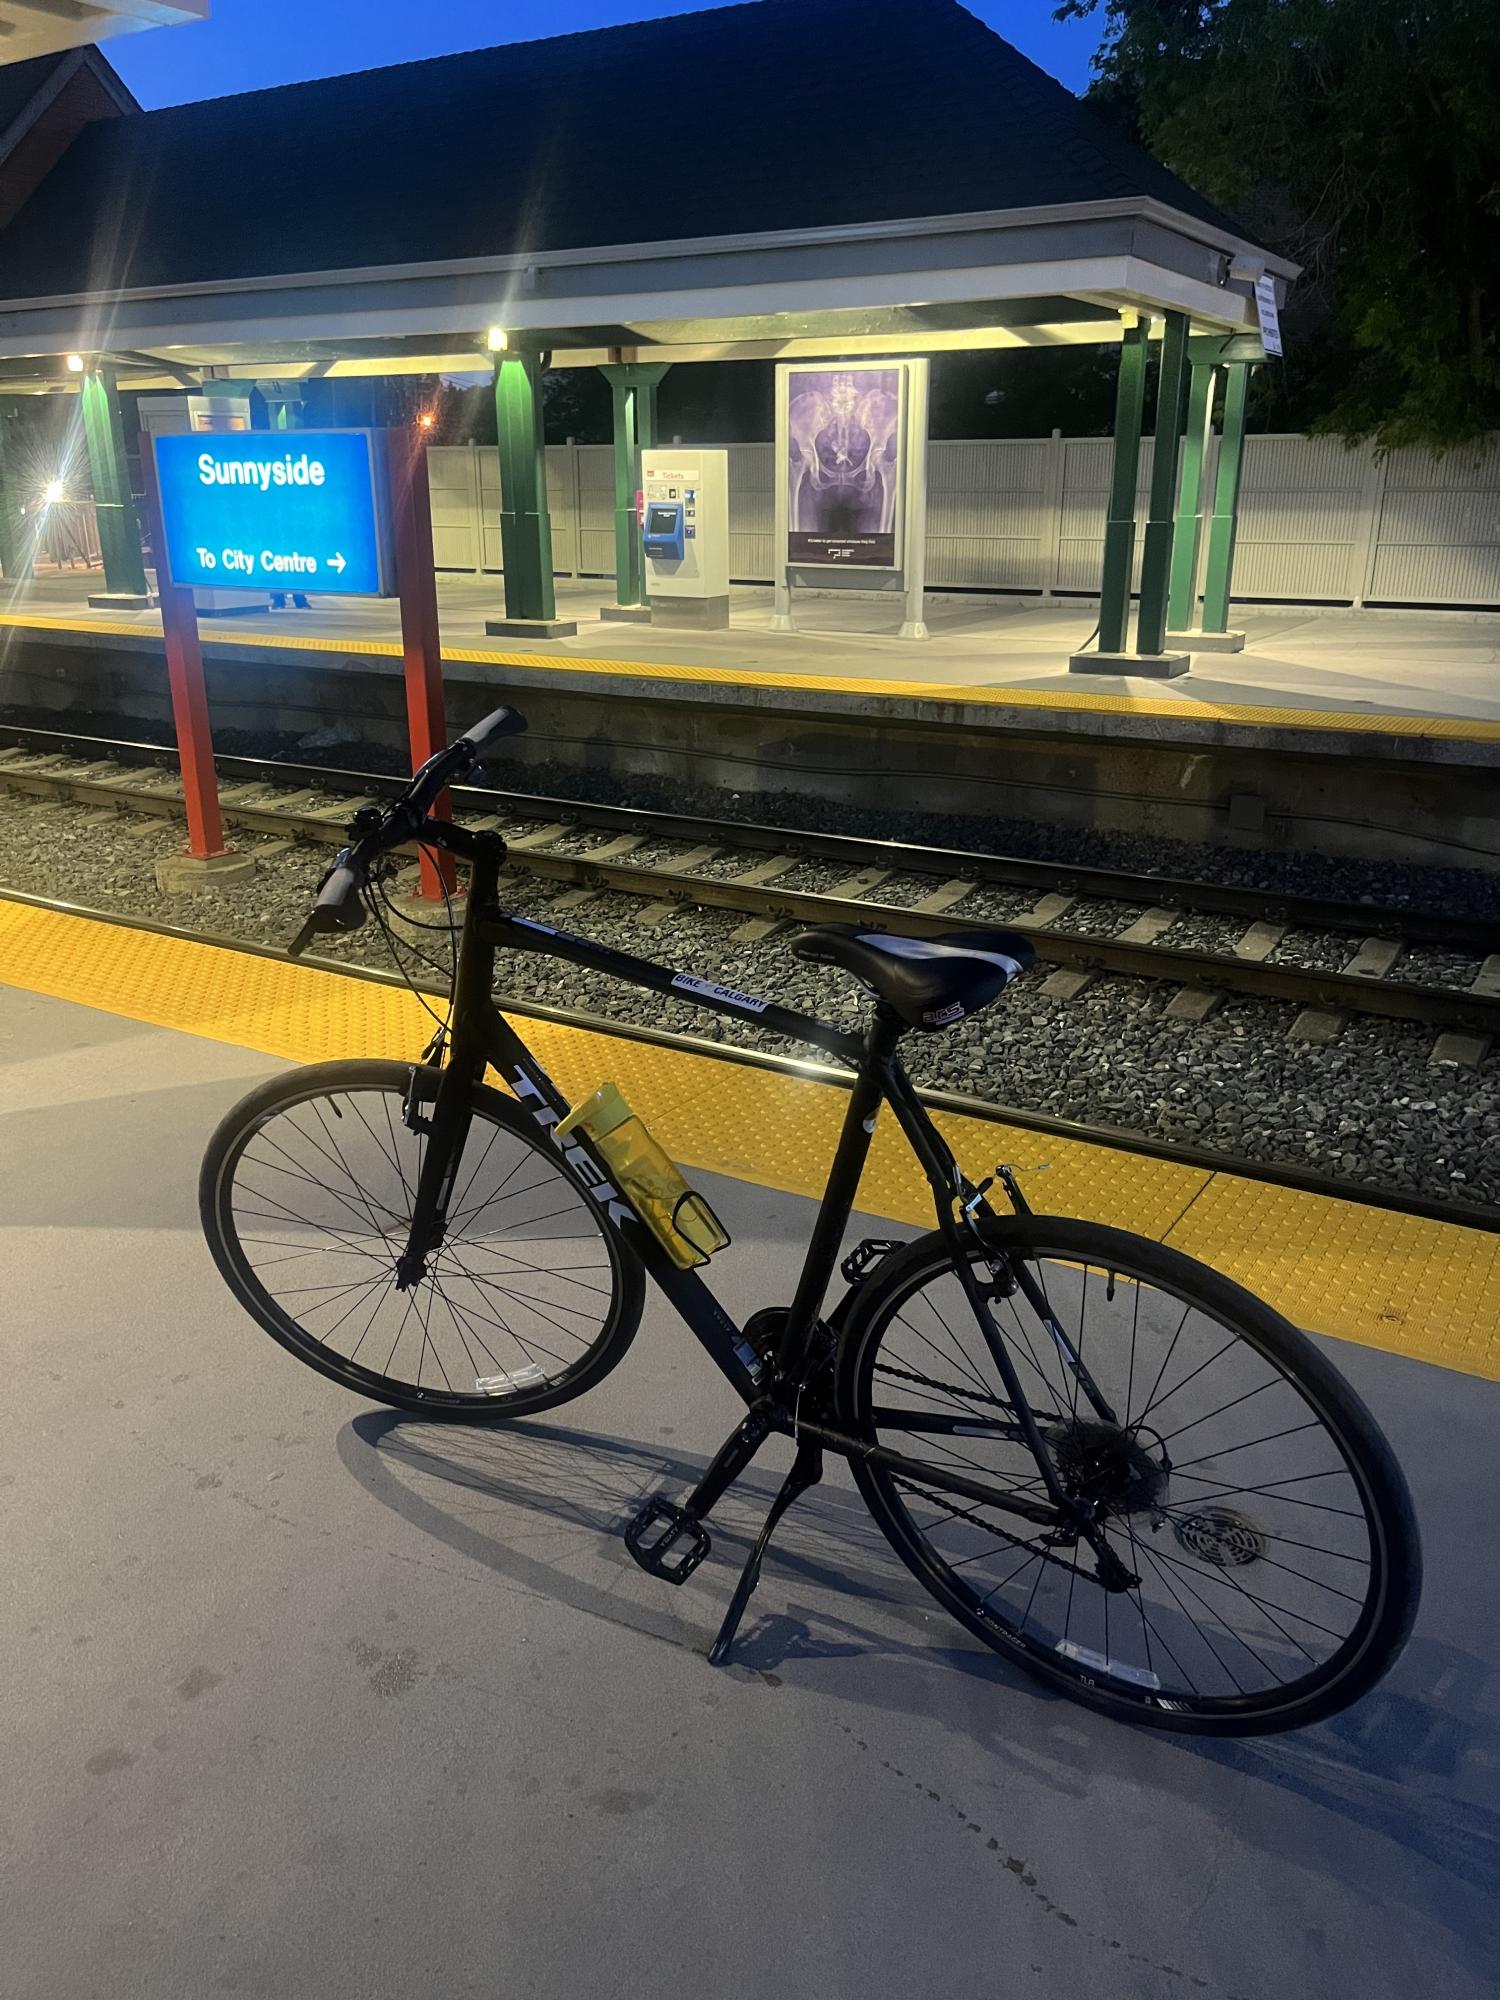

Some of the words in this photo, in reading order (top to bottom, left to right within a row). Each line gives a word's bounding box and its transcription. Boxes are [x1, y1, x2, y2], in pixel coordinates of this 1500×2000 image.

[198, 453, 325, 491] Sunnyside
[196, 548, 216, 569] To
[222, 549, 254, 574] City
[260, 551, 317, 574] Centre
[675, 974, 703, 988] BIKE
[714, 987, 767, 1007] CALGARY
[511, 1064, 639, 1230] TREK
